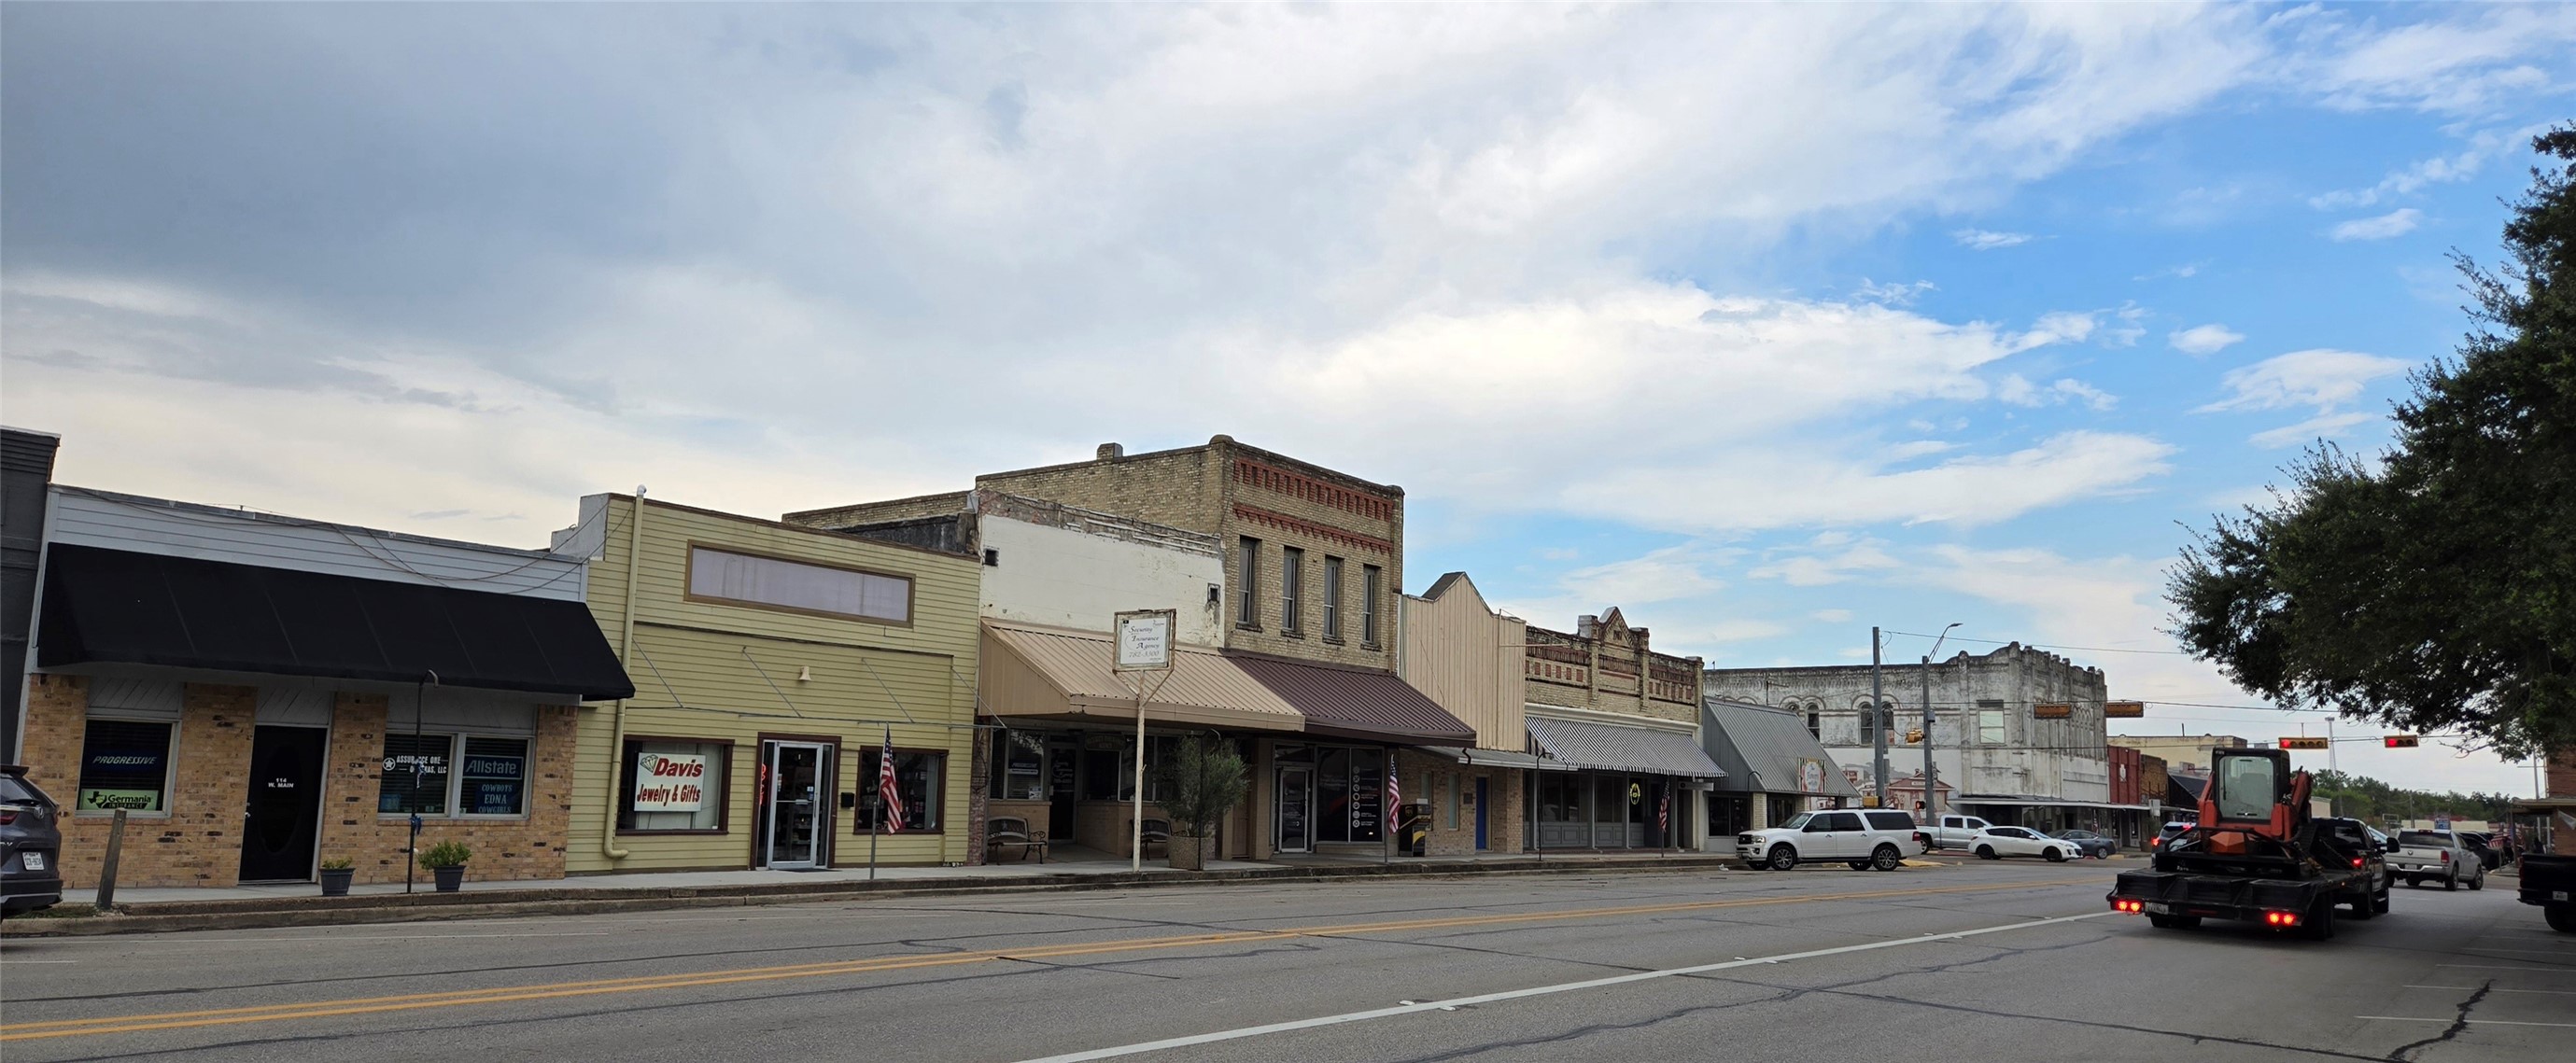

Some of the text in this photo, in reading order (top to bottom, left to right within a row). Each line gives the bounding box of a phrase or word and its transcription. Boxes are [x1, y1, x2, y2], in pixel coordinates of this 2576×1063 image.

[1135, 642, 1160, 650] Agency
[91, 755, 157, 764] PROGRESSIVE
[396, 755, 441, 764] ASSURCE ONE
[437, 765, 447, 774] LLC
[465, 760, 516, 775] Allstate
[654, 757, 703, 777] Davis
[481, 784, 513, 792] COWBOYS
[108, 794, 151, 803] Germania
[484, 793, 507, 804] EDNA
[637, 784, 701, 806] Jewelry & Gifts
[478, 805, 512, 814] COWGIRLS
